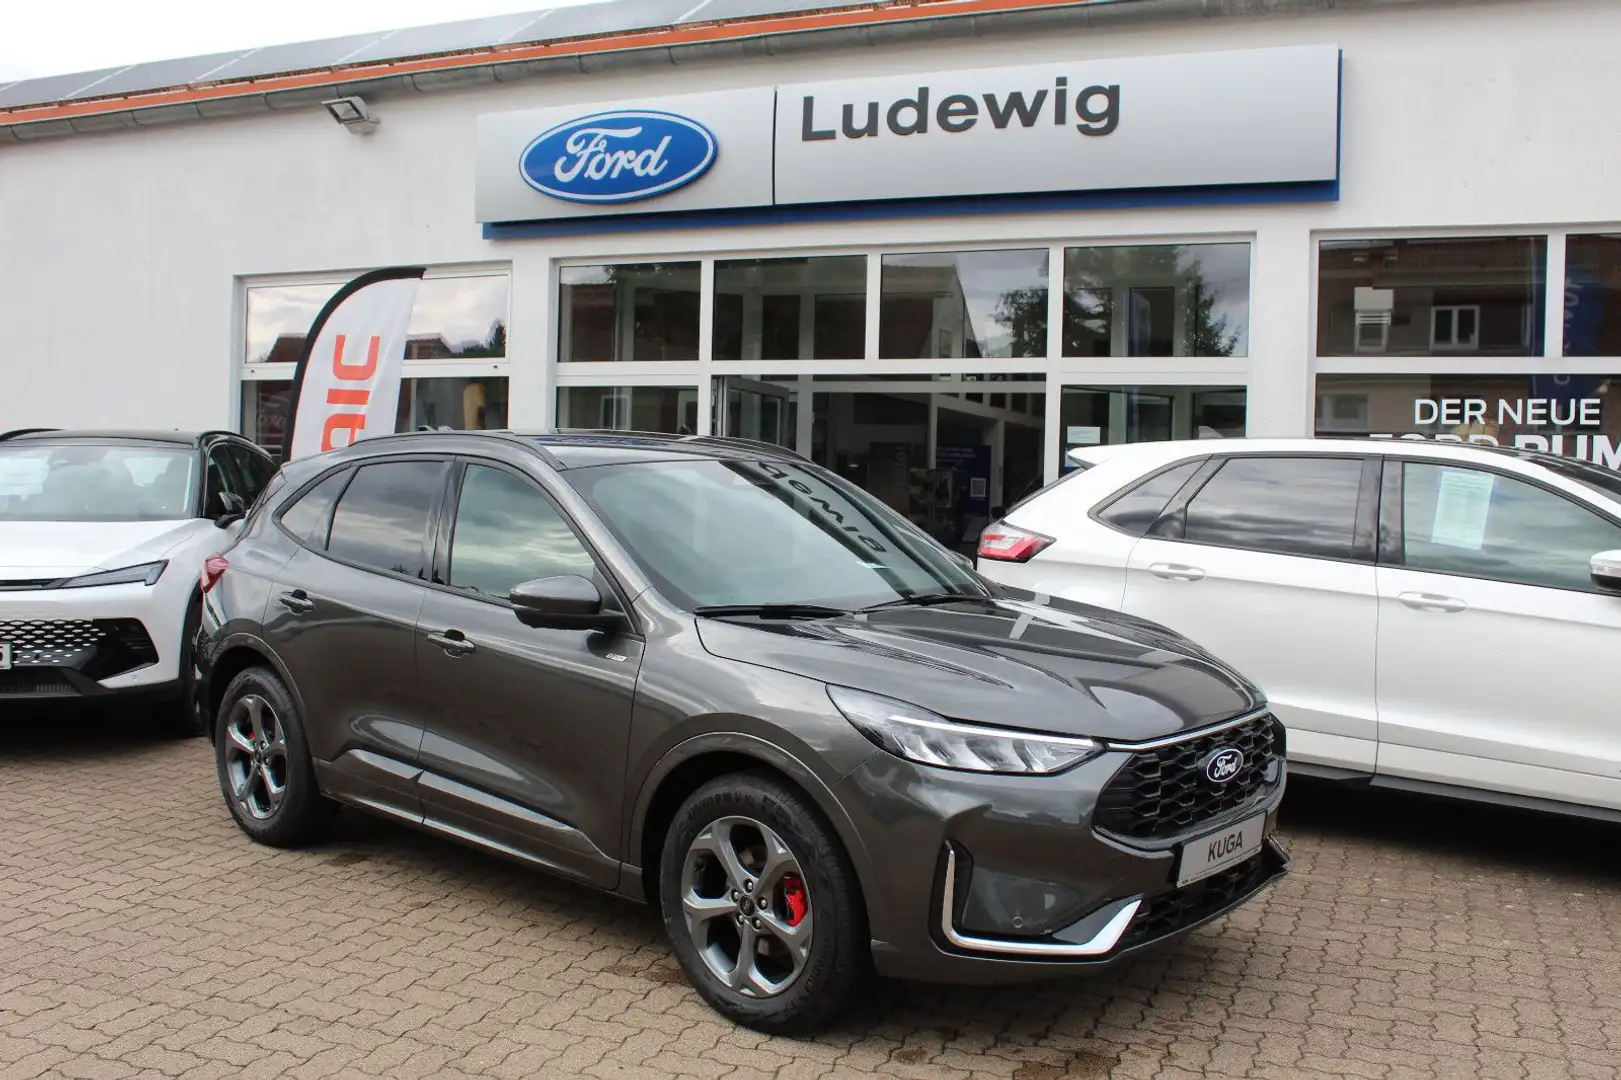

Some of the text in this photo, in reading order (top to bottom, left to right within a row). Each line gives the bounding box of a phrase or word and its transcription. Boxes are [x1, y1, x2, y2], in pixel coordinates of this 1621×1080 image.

[802, 77, 1121, 141] Ludewig
[554, 126, 672, 182] Ford
[1414, 398, 1601, 426] DER NEUE
[1214, 754, 1238, 778] Ford
[1207, 830, 1243, 862] KUGA
